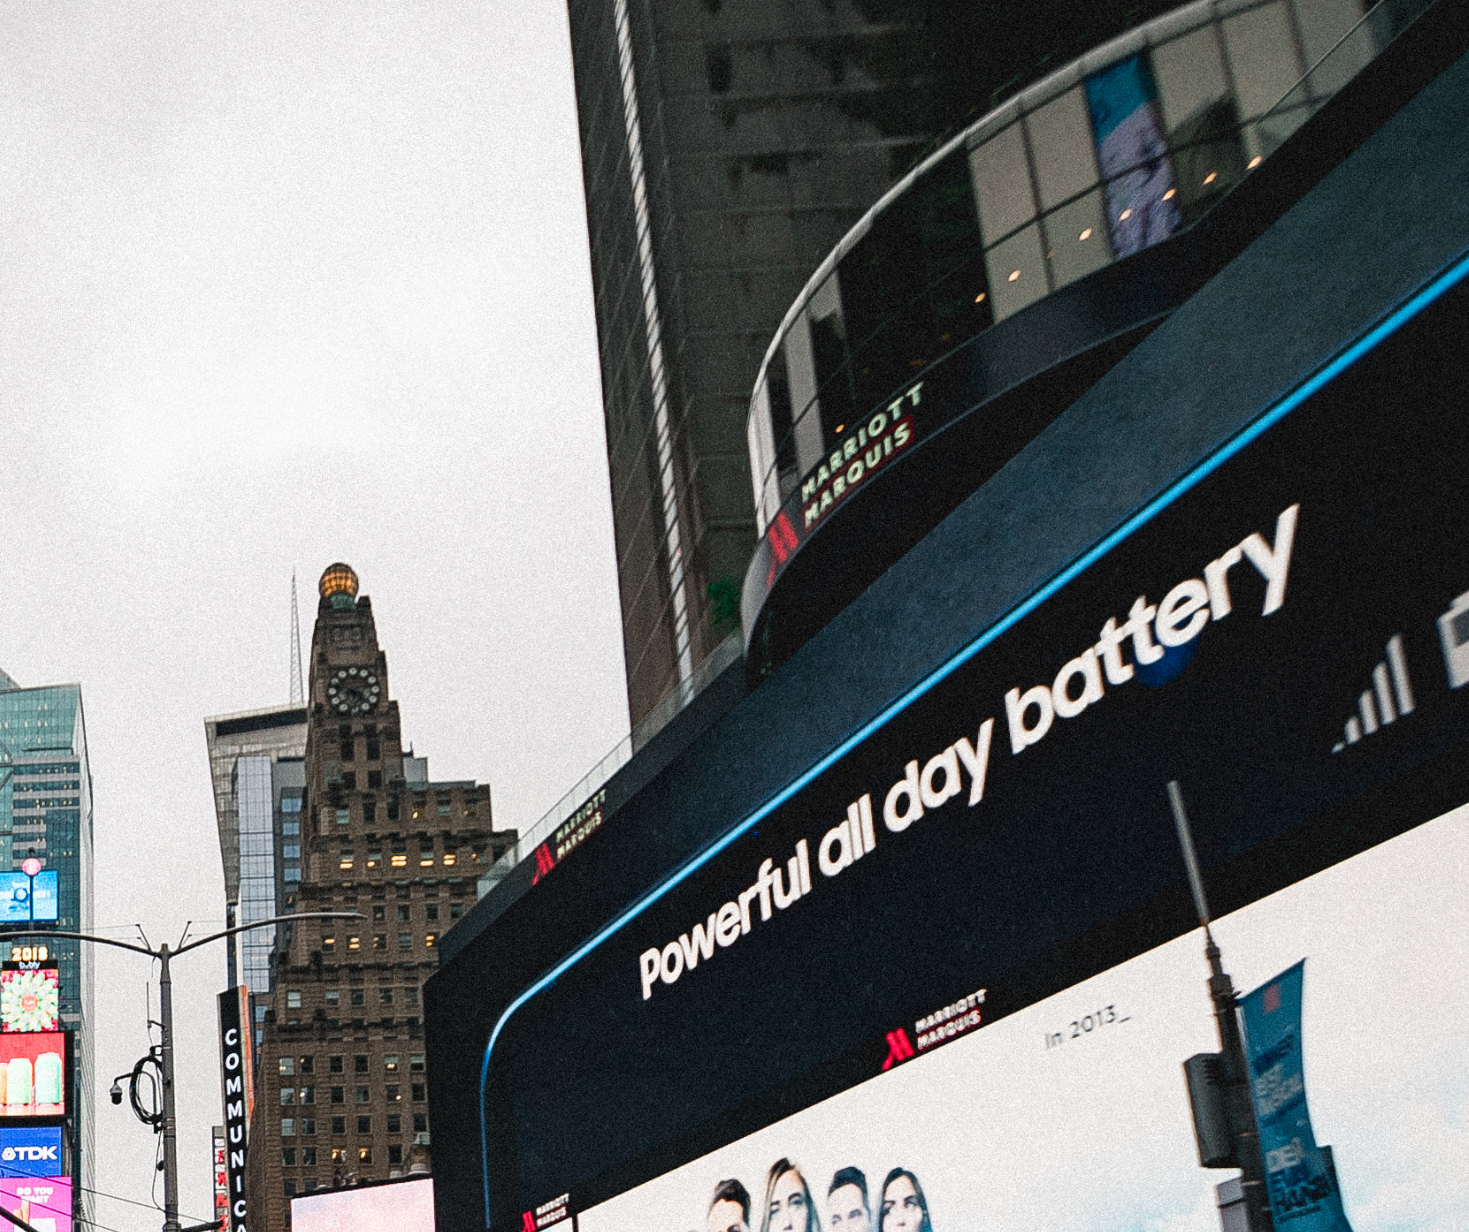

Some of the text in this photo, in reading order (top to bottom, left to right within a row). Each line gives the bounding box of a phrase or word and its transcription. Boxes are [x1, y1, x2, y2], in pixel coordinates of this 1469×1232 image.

[802, 381, 924, 502] MARRIOTT
[804, 422, 912, 528] MARQUIS
[639, 502, 1300, 1001] Powerful all day battery
[12, 946, 48, 961] 2018
[915, 989, 987, 1033] MARRIOTT
[917, 1009, 981, 1049] MARQUIS
[14, 1146, 58, 1161] TDK
